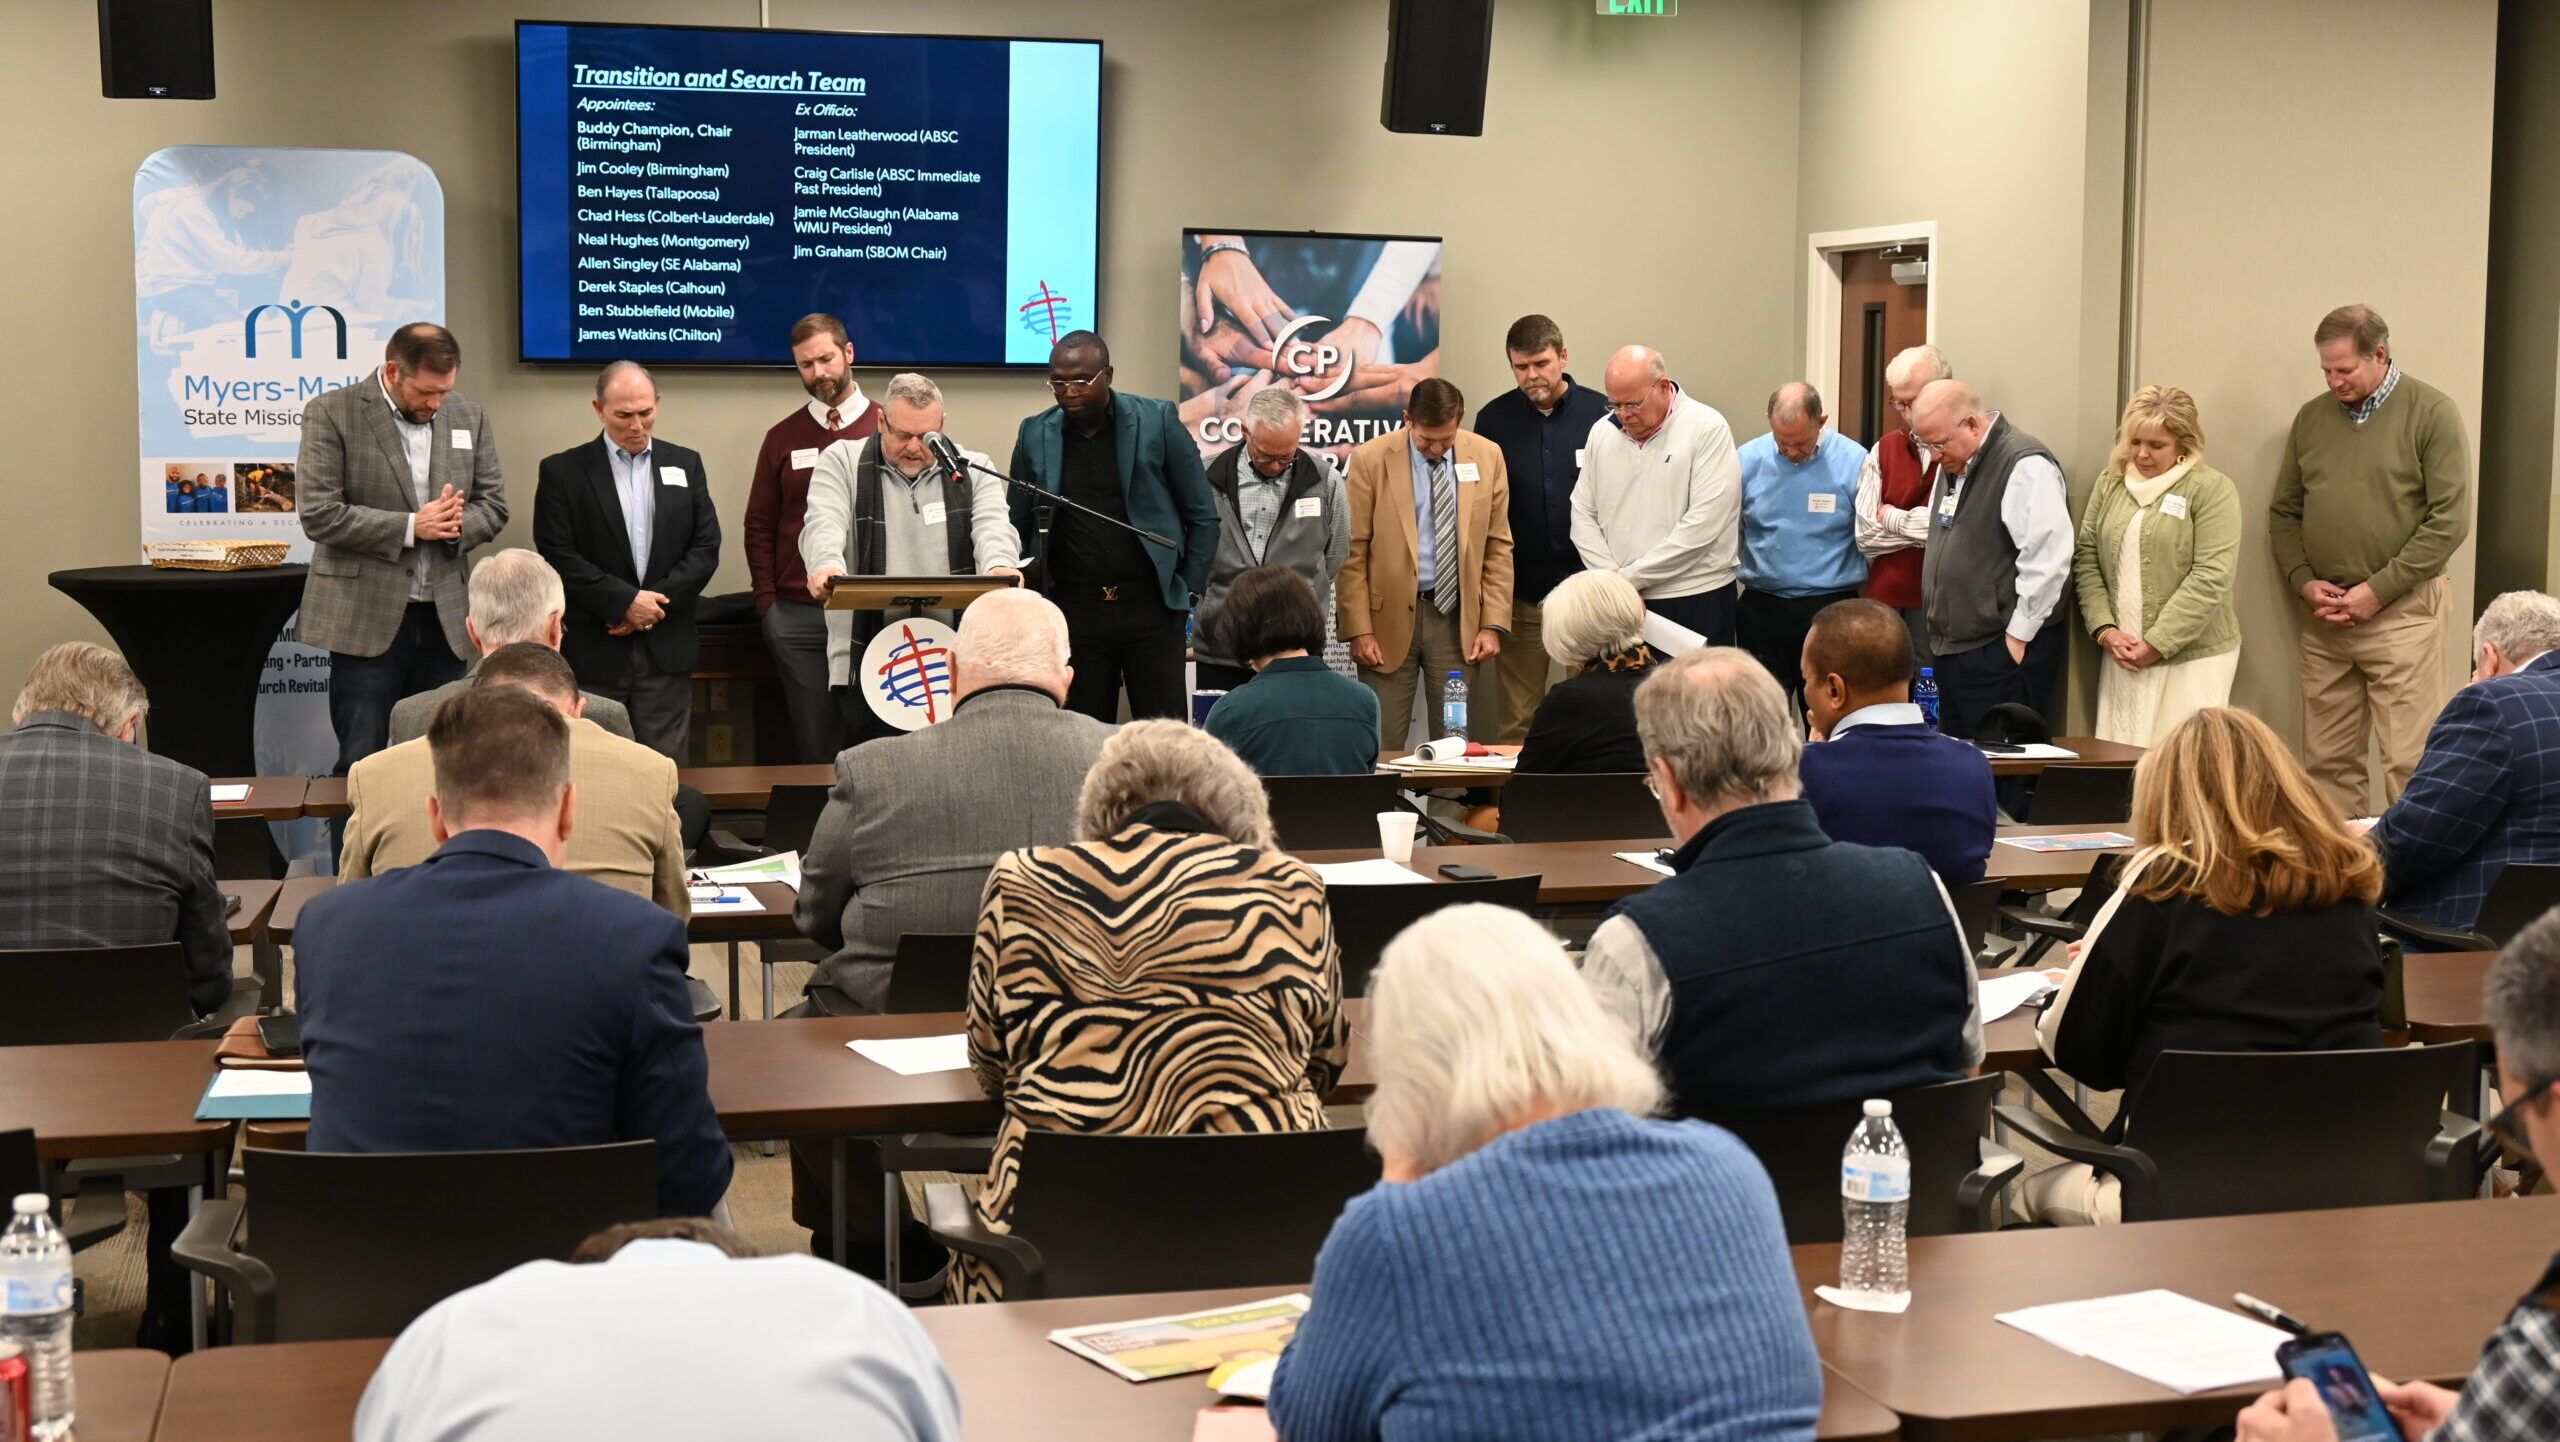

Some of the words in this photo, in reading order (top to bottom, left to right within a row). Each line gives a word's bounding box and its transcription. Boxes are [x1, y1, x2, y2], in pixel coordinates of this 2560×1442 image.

[574, 64, 679, 86] Transition
[684, 69, 727, 88] and
[731, 70, 803, 90] Search
[808, 72, 865, 91] Team
[577, 97, 655, 112] Appointees:
[795, 103, 811, 115] Ex
[813, 104, 858, 117] Officio:
[578, 121, 620, 136] Buddy
[622, 122, 694, 138] Champion,
[697, 124, 732, 137] Chair
[794, 127, 835, 141] Jarman
[839, 128, 917, 142] Leatherwood
[920, 129, 958, 144] (ABSC
[577, 137, 661, 153] (Birmingham)
[795, 143, 855, 157] President)
[576, 161, 596, 176] Jim
[599, 162, 644, 177] Cooley
[647, 162, 729, 179] (Birmingham)
[794, 166, 827, 181] Craig
[830, 167, 874, 180] Carlisle
[877, 168, 915, 182] (ABSC
[918, 169, 980, 182] Immediate
[578, 185, 602, 197] Ben
[605, 186, 643, 200] Hayes
[646, 186, 719, 201] (Tallapoosa)
[795, 182, 819, 194] Past
[822, 183, 882, 197] President)
[578, 209, 612, 221] Chad
[615, 210, 645, 222] Hess
[648, 210, 774, 226] (Colbert-Lauderdale)
[793, 206, 827, 220] Jamie
[830, 206, 900, 222] McGlaughn
[903, 207, 958, 221] (Alabama
[794, 221, 829, 233] WMU
[832, 222, 892, 236] President)
[579, 233, 607, 245] Neal
[611, 234, 659, 248] Hughes
[661, 234, 749, 250] (Montgomery)
[793, 245, 812, 259] Jim
[815, 245, 863, 257] Graham
[866, 245, 908, 259] (SBOM
[911, 247, 946, 261] Chair)
[578, 257, 610, 269] Allen
[613, 257, 659, 272] Singley
[661, 257, 680, 271] (SE
[683, 259, 741, 273] Alabama)
[579, 280, 616, 292] Derek
[619, 281, 664, 295] Staples
[666, 281, 725, 296] (Calhoun)
[579, 304, 603, 316] Ben
[606, 304, 680, 317] Stubblefield
[683, 305, 734, 319] (Mobile)
[578, 328, 616, 342] James
[617, 328, 667, 340] Watkins
[669, 328, 721, 342] (Chilton)
[1287, 344, 1339, 374] CP
[184, 375, 359, 407] Myers-Ma
[184, 409, 237, 425] State
